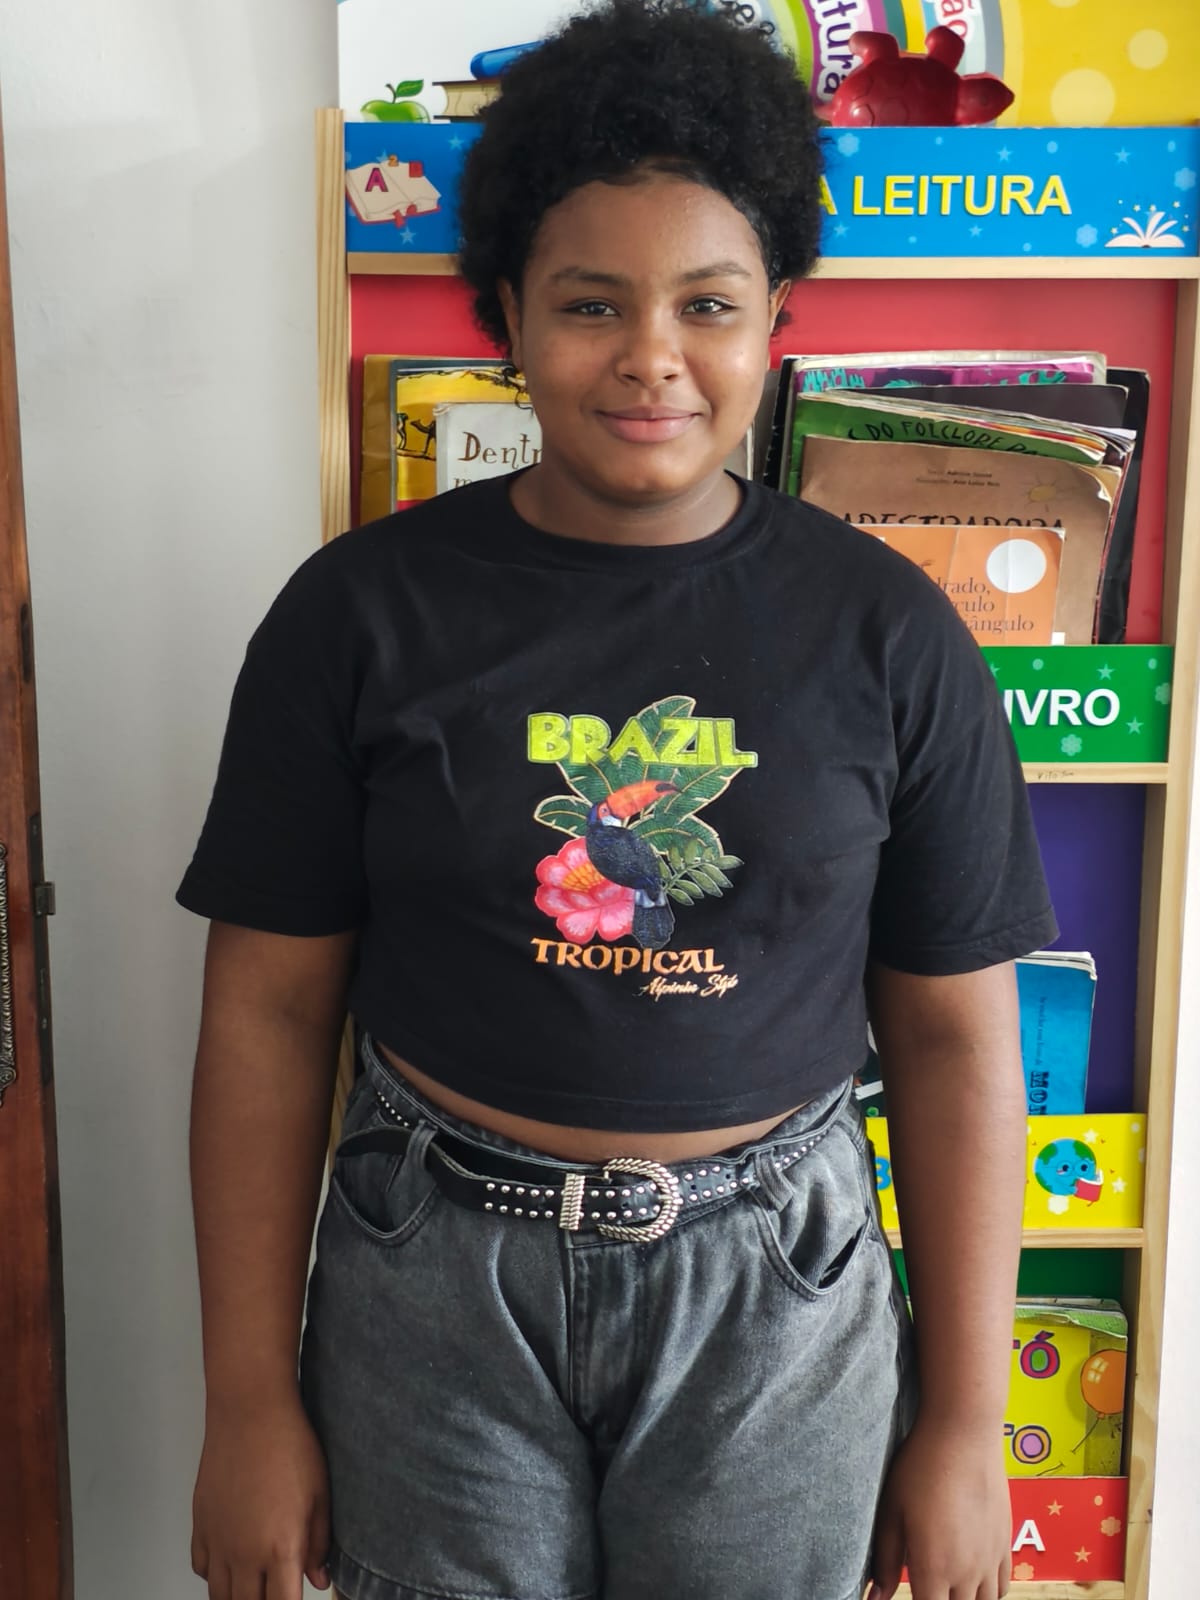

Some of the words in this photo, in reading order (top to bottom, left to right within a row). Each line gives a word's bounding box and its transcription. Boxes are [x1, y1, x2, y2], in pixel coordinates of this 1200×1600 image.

[818, 0, 857, 94] tura
[853, 174, 1073, 216] LEITURA
[965, 614, 1034, 634] ângulo
[528, 713, 758, 768] BRAZIL
[530, 937, 725, 976] TROPICAL
